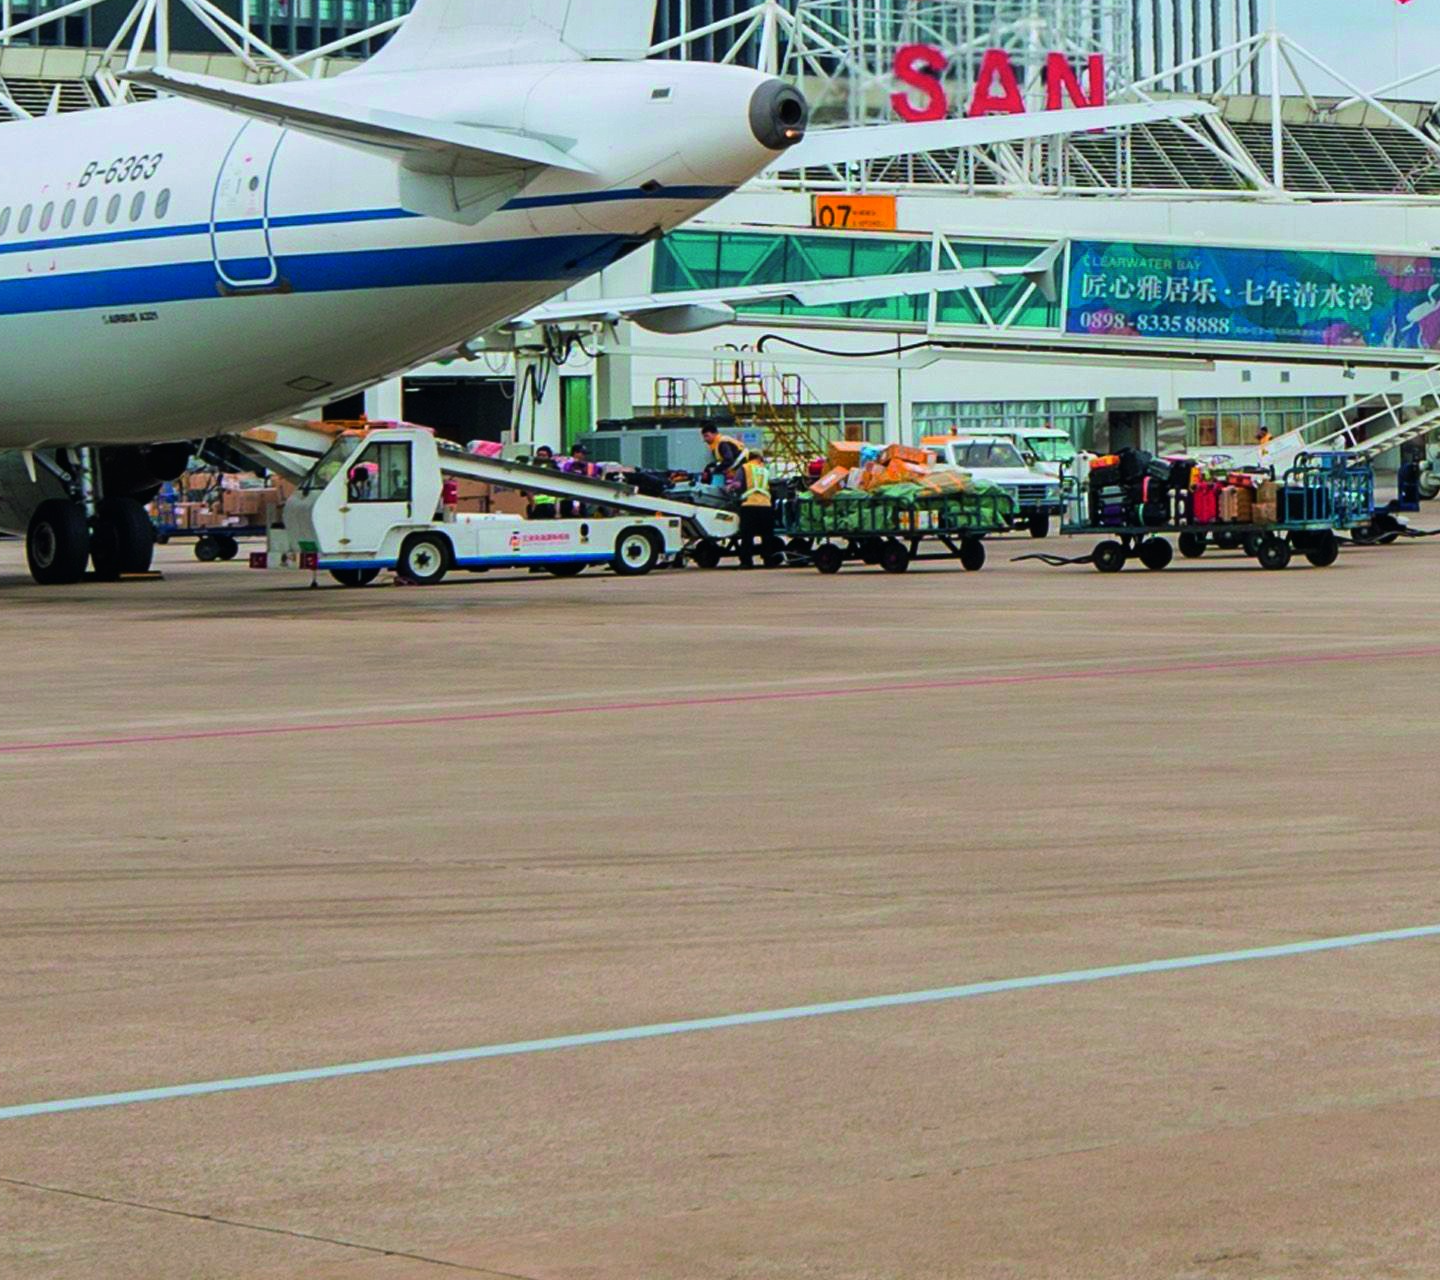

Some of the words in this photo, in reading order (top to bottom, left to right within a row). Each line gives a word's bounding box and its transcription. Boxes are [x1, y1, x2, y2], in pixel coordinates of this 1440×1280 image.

[890, 43, 1107, 130] SAN
[78, 152, 163, 188] B-6363
[818, 204, 852, 228] 07
[1083, 252, 1173, 270] CLEARWATER
[1176, 256, 1203, 272] BAY
